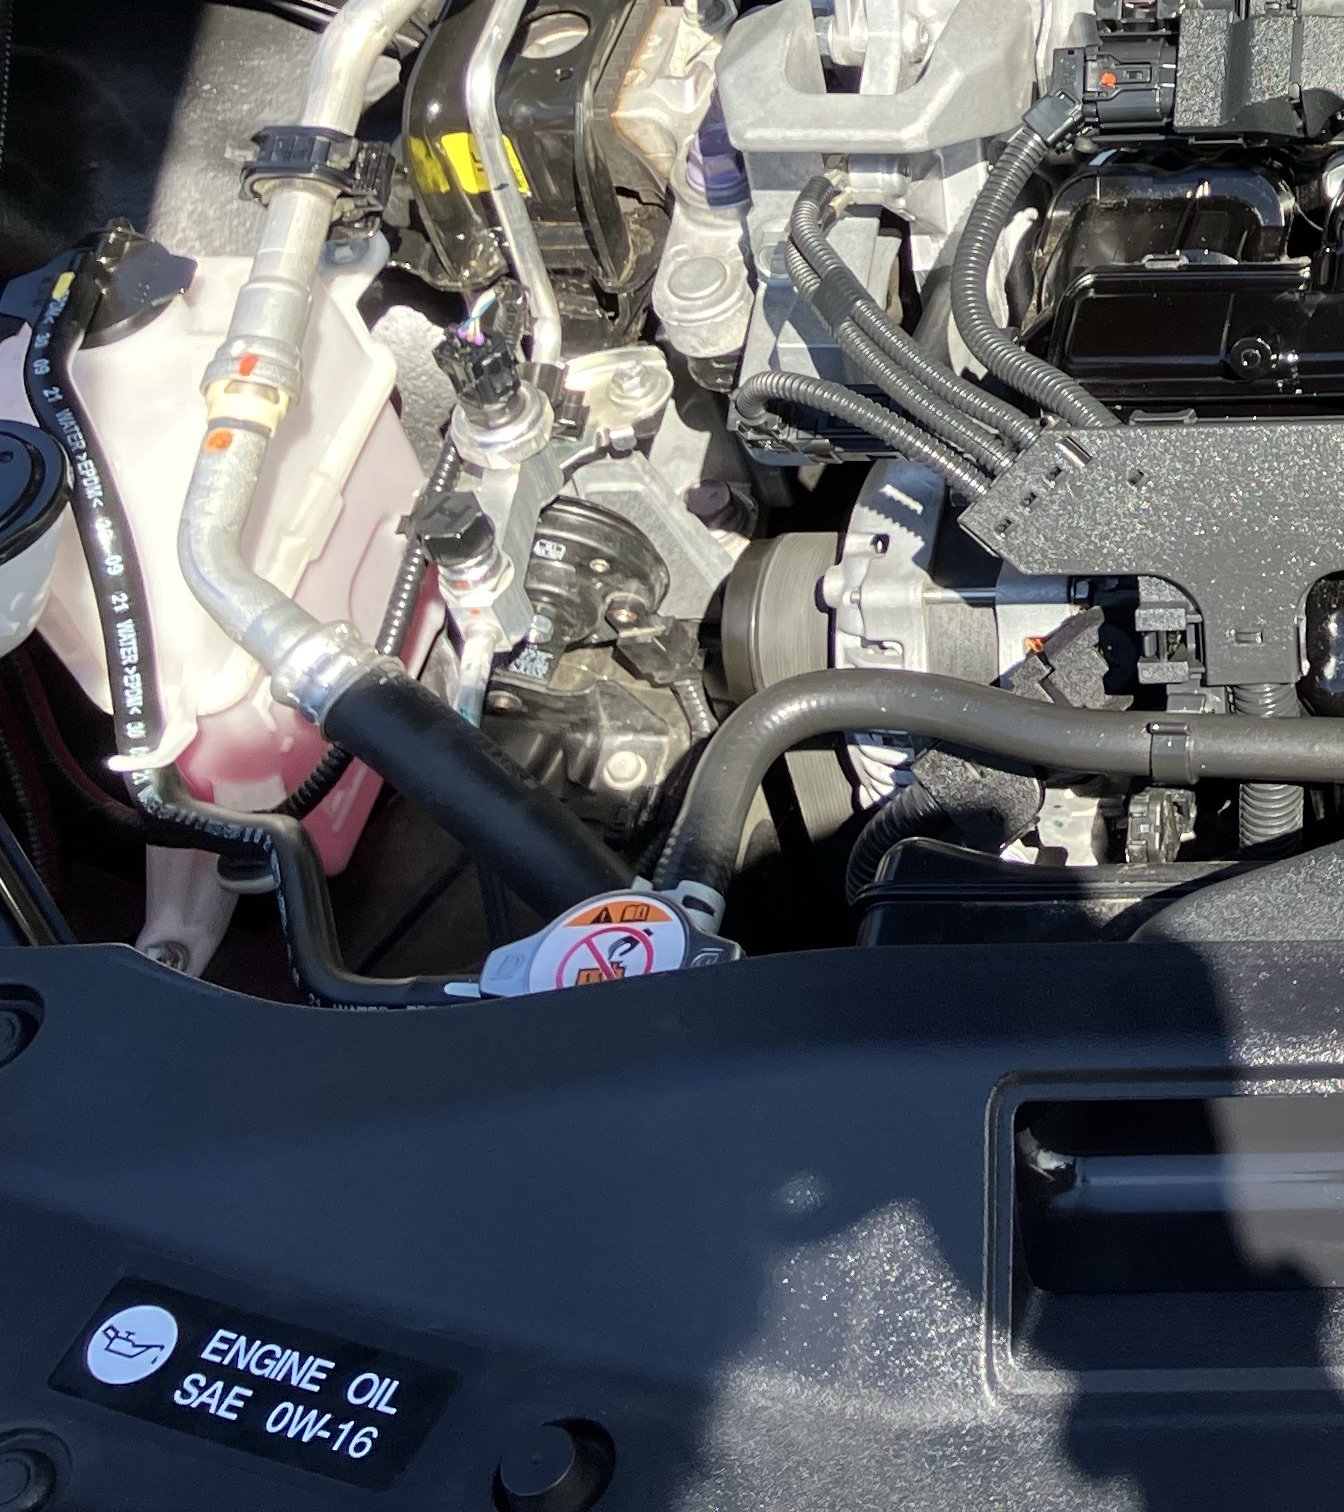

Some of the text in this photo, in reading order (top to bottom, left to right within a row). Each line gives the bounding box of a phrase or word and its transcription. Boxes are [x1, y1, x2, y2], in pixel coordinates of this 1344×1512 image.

[43, 387, 63, 402] 21
[105, 555, 124, 575] 09
[111, 593, 129, 612] 21
[200, 1328, 400, 1416] ENGINE OIL
[173, 1373, 379, 1459] SAE 0W-16
